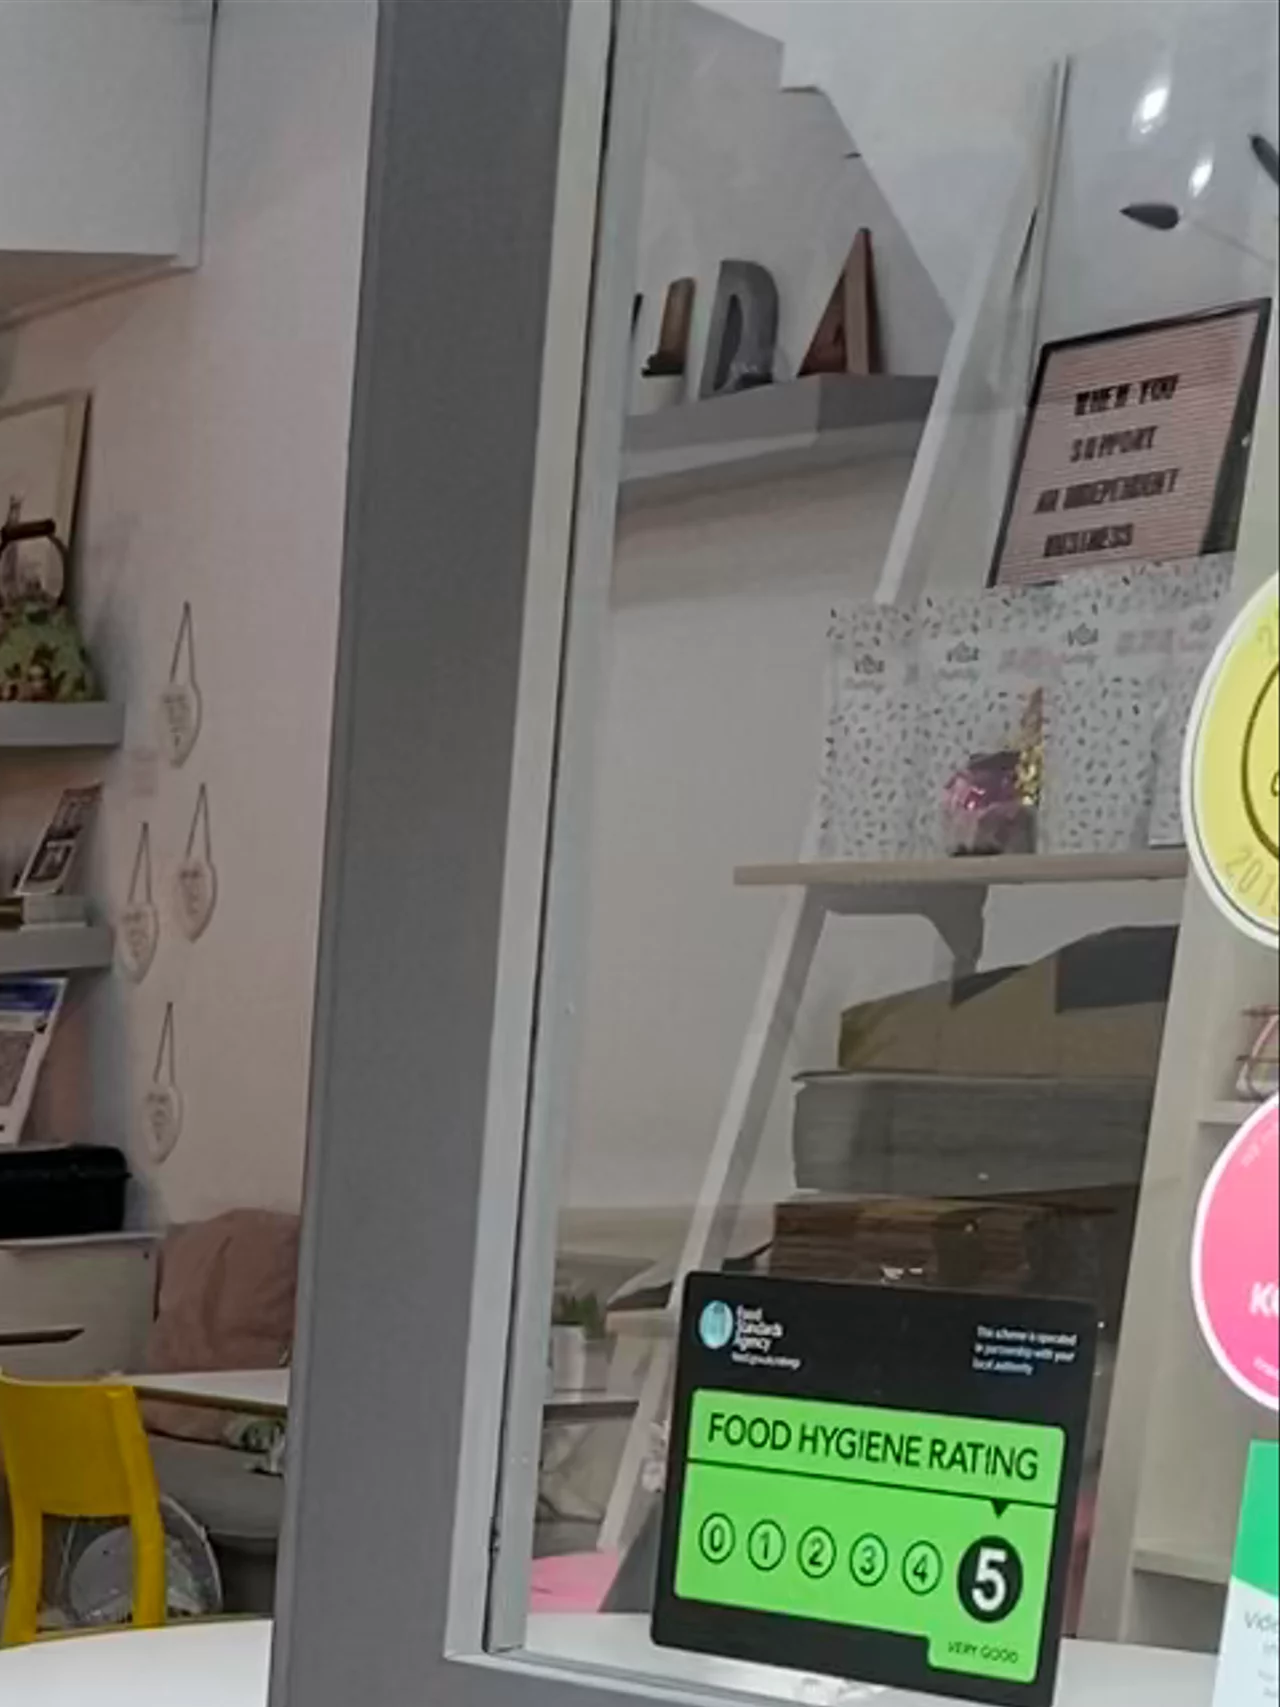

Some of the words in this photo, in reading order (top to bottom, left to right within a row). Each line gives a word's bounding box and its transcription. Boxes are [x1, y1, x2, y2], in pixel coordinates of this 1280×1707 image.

[1074, 382, 1131, 416] WHEN
[1138, 373, 1180, 404] YOU
[1070, 425, 1158, 463] SUPPORT
[1033, 488, 1059, 516] AN
[1062, 467, 1180, 511] INDEPENDENT
[1043, 521, 1134, 558] BUSINESS
[708, 1412, 793, 1450] FOOD
[798, 1423, 923, 1467] HYGIENE
[929, 1438, 1038, 1481] RATING
[709, 1523, 726, 1553] 0
[809, 1537, 826, 1567] 2
[860, 1545, 877, 1576] 3
[912, 1552, 929, 1584] 4
[971, 1546, 1007, 1612] 5
[948, 1640, 977, 1660] VERY
[980, 1645, 1020, 1665] GOOD
